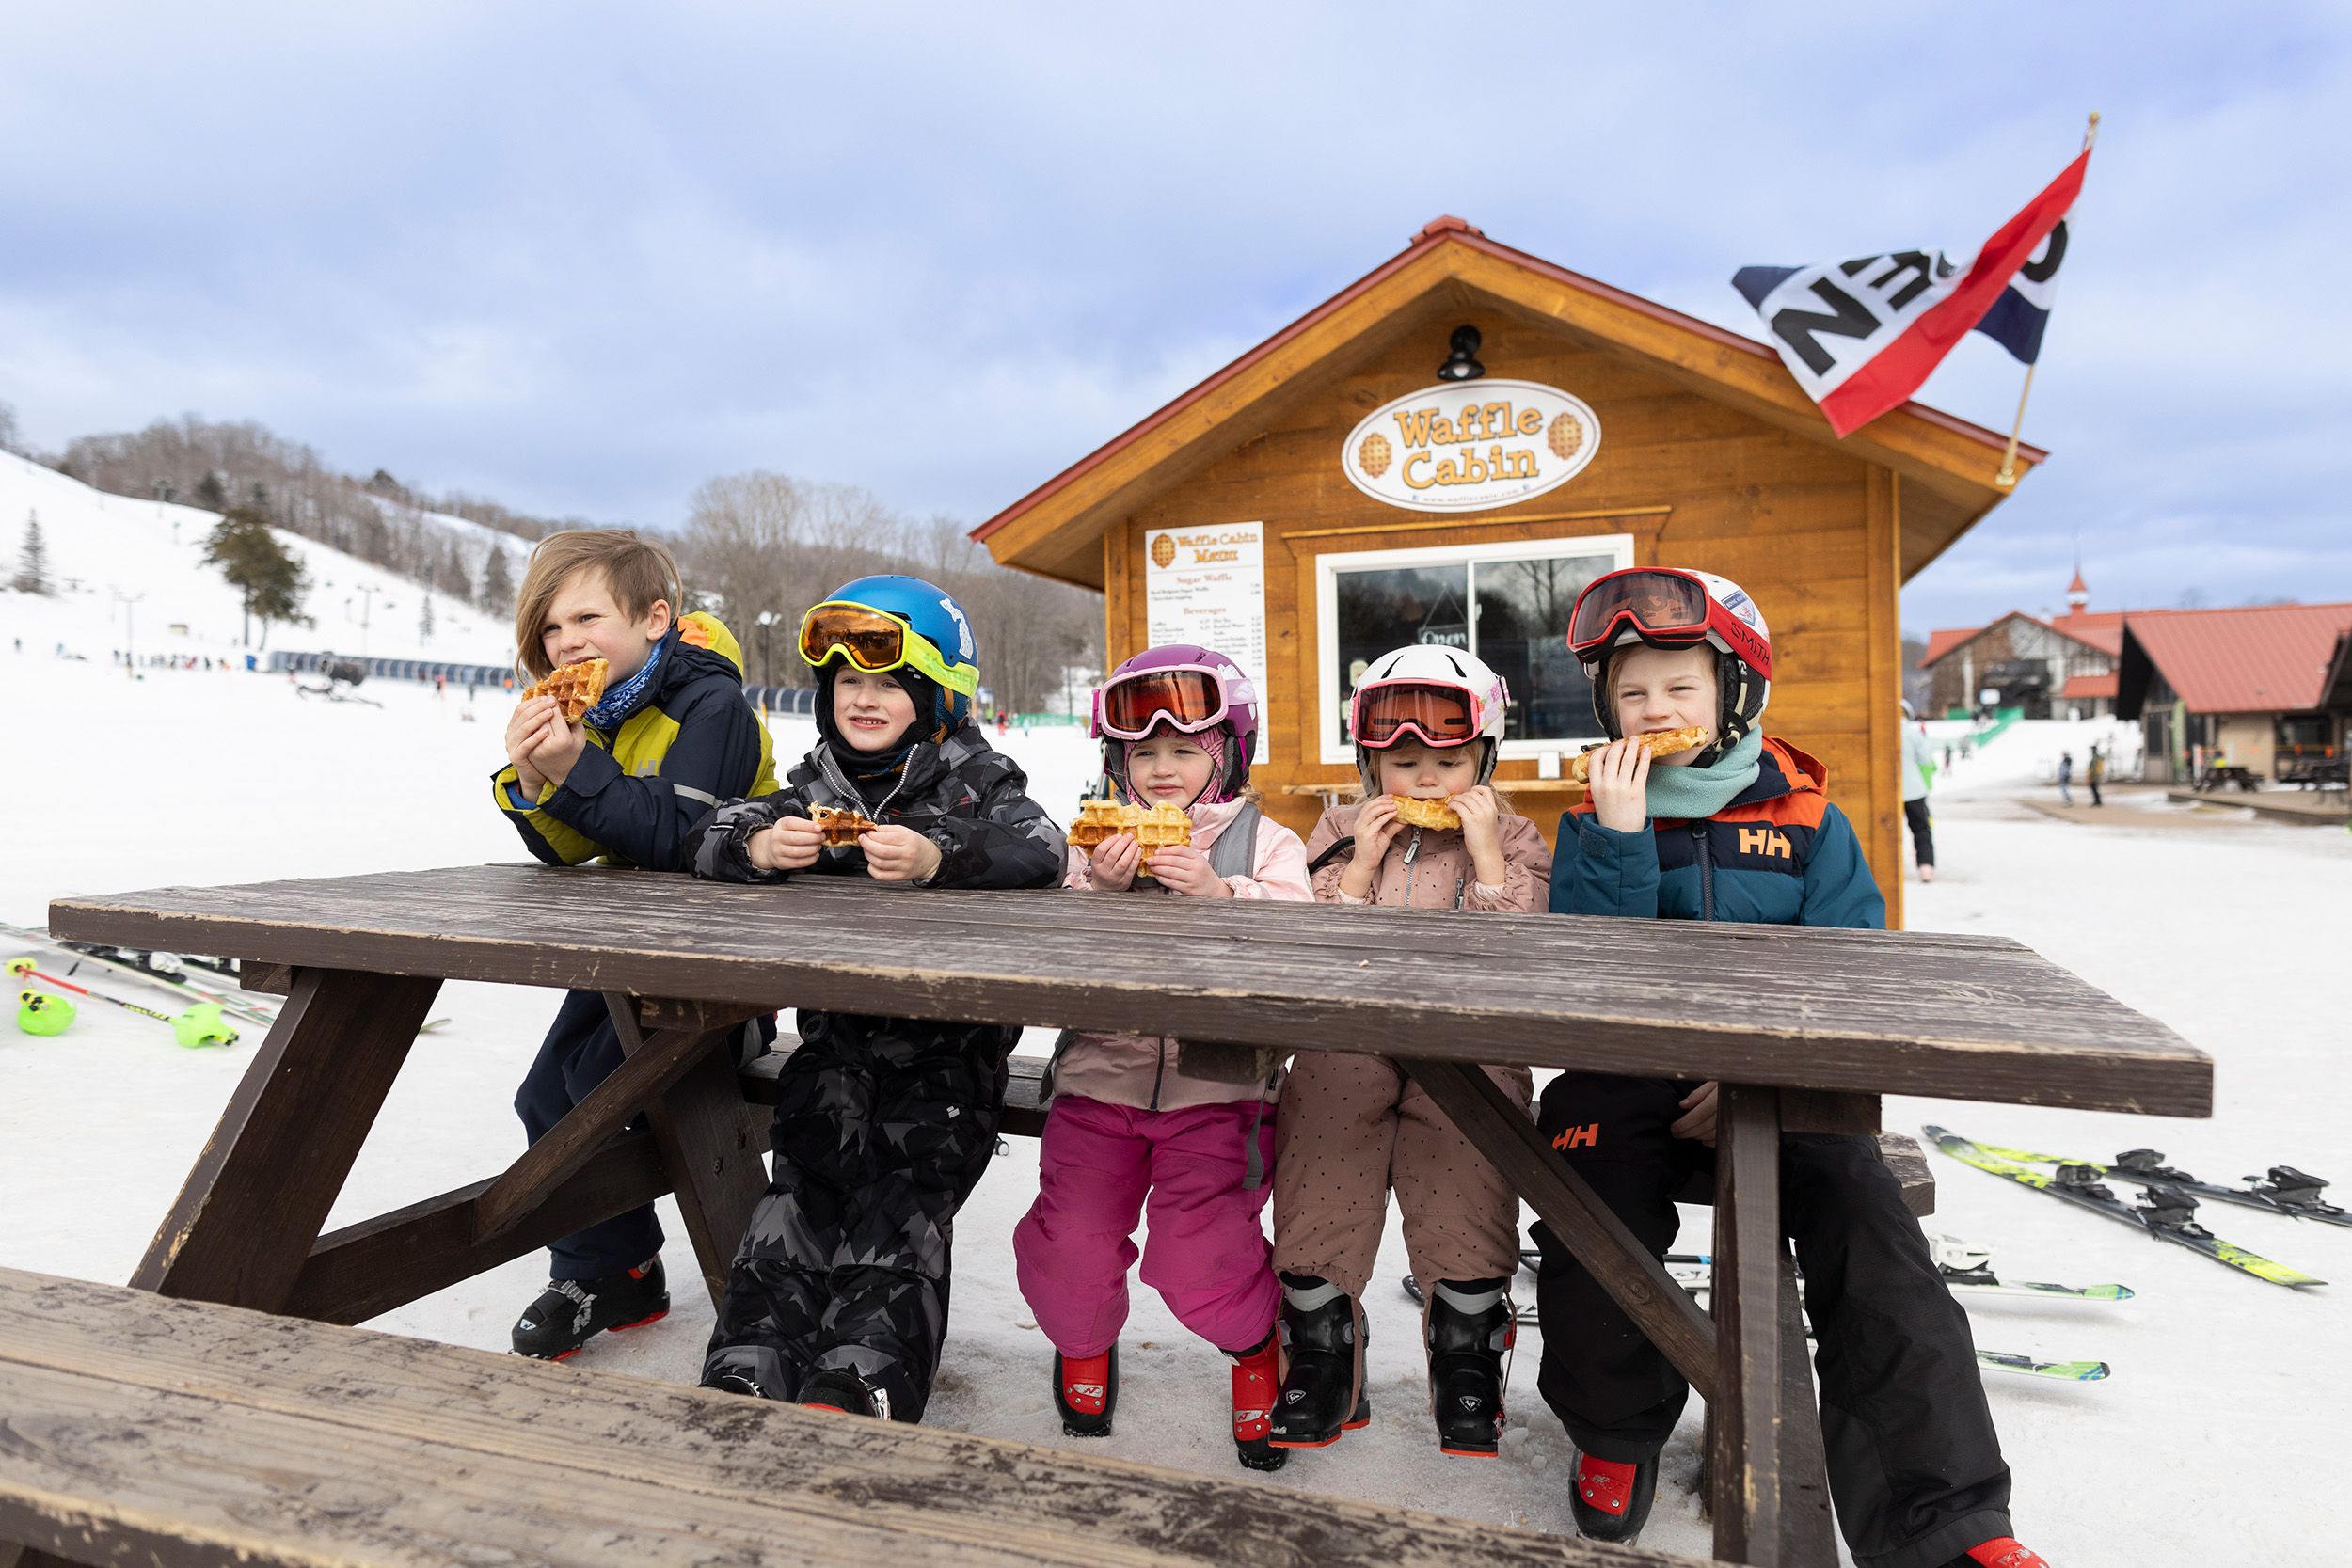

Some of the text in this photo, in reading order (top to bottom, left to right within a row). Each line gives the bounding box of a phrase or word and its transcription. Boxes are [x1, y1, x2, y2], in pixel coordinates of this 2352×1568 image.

[1393, 401, 1543, 448] Waffle
[1402, 445, 1540, 489] Cabin
[1176, 531, 1258, 547] Waffle Cabin
[1194, 548, 1239, 563] Menu
[1731, 622, 1771, 666] SMITH
[1739, 828, 1791, 859] HH
[1552, 1123, 1599, 1151] HH
